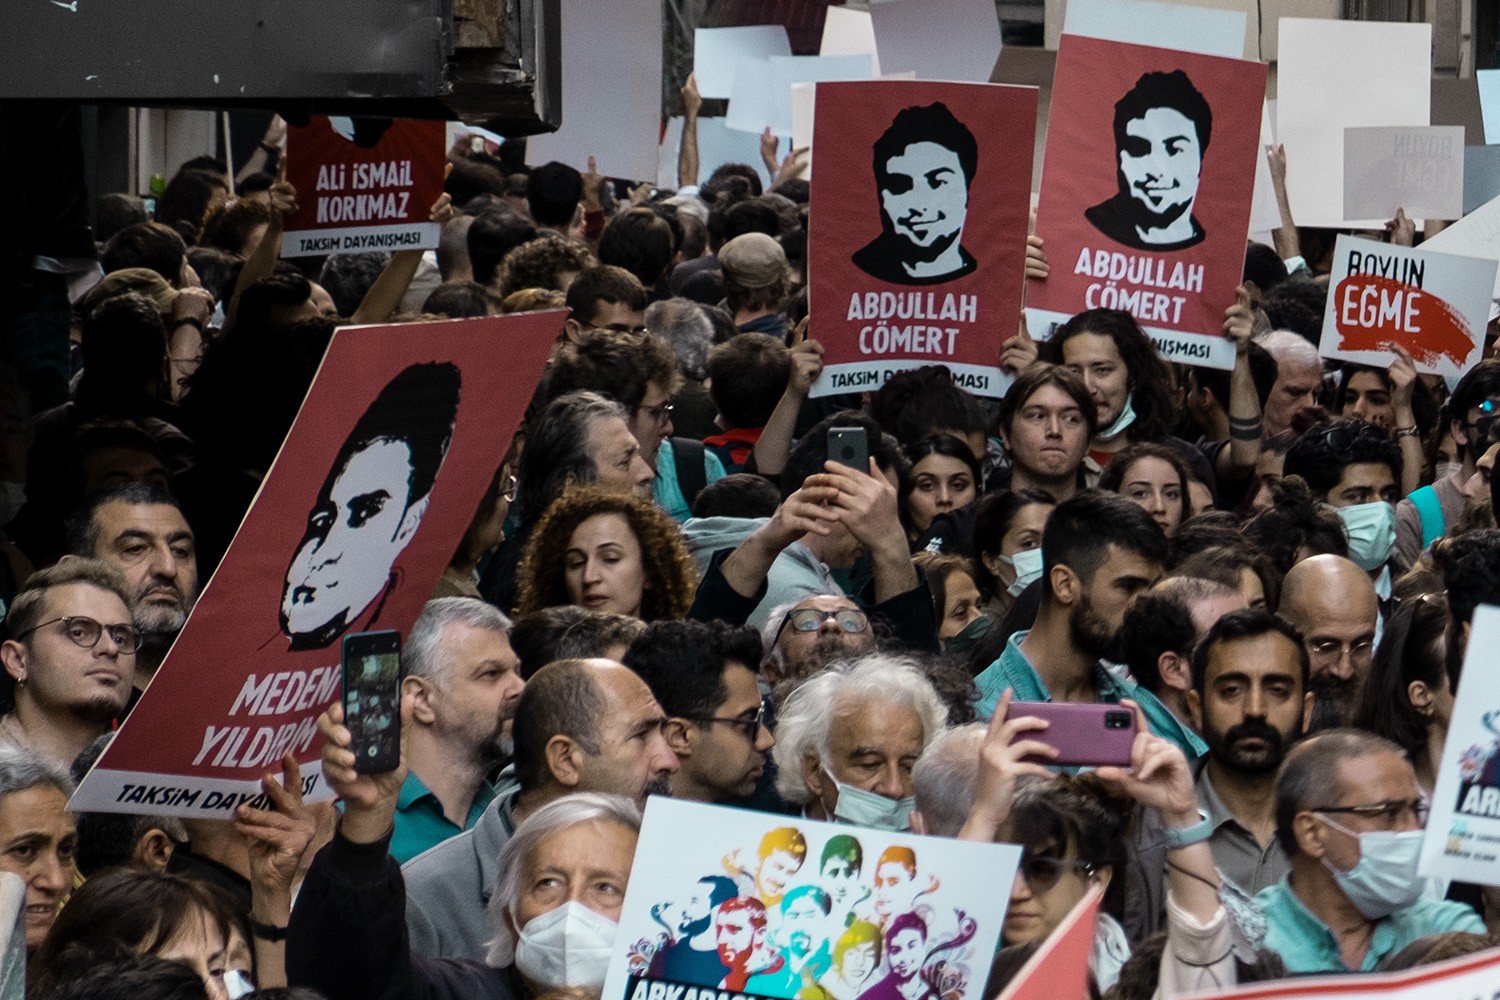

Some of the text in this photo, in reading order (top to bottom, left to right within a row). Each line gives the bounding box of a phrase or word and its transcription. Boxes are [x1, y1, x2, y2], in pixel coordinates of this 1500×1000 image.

[317, 192, 410, 223] KORKMAZ
[344, 232, 421, 249] DAYANIŞMASI
[1074, 247, 1204, 293] ABDULLAH
[1347, 250, 1425, 290] BOYUN
[847, 292, 977, 322] ABDULLAH
[1085, 280, 1186, 324] CÖMERT
[1341, 284, 1422, 333] EĞME
[859, 321, 959, 355] CÖMERT
[192, 715, 319, 769] YILDIRIM
